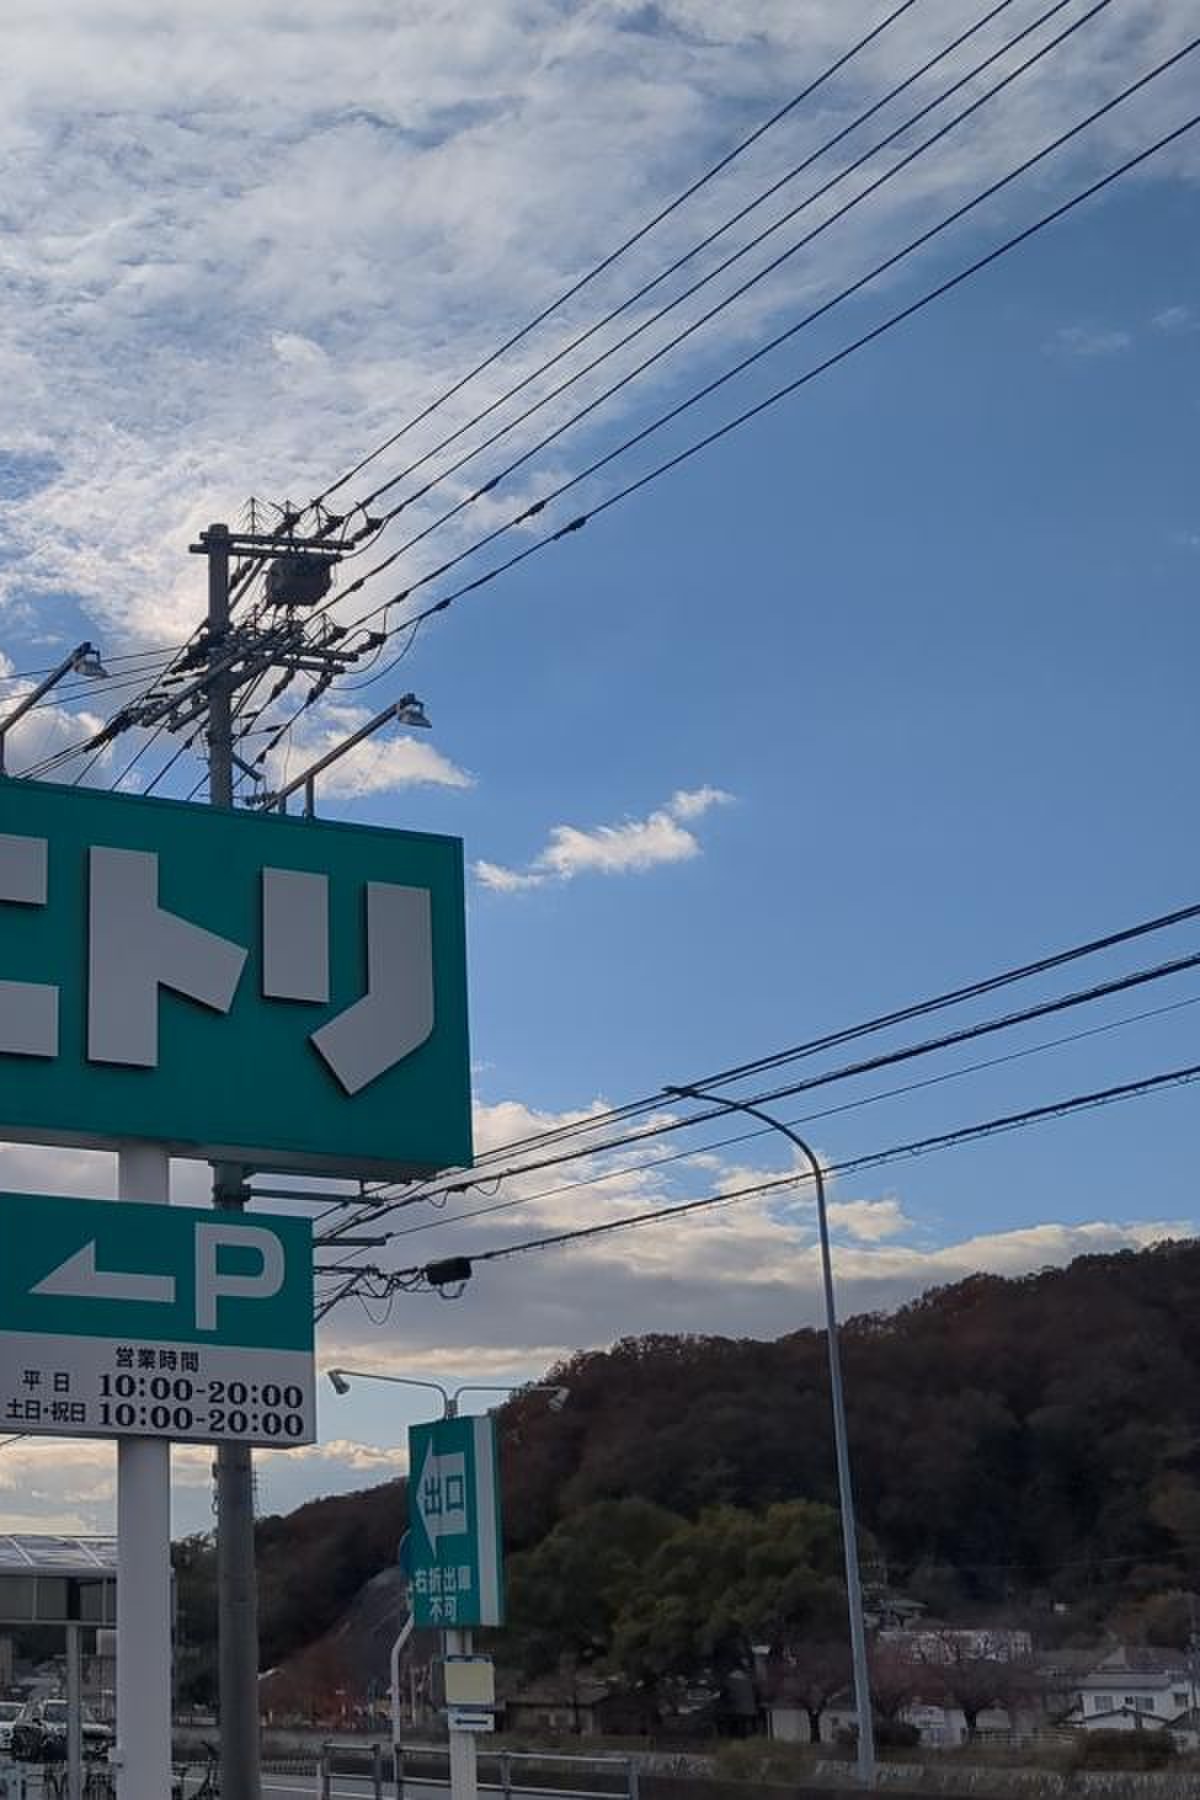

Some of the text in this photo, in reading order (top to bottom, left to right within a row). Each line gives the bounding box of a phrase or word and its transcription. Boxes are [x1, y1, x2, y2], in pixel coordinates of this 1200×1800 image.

[195, 1221, 286, 1331] P
[115, 1348, 200, 1373] 営業時間
[99, 1374, 304, 1409] 10:00-20:00
[99, 1403, 304, 1437] 10:00-20:00
[424, 1475, 465, 1516] 出口
